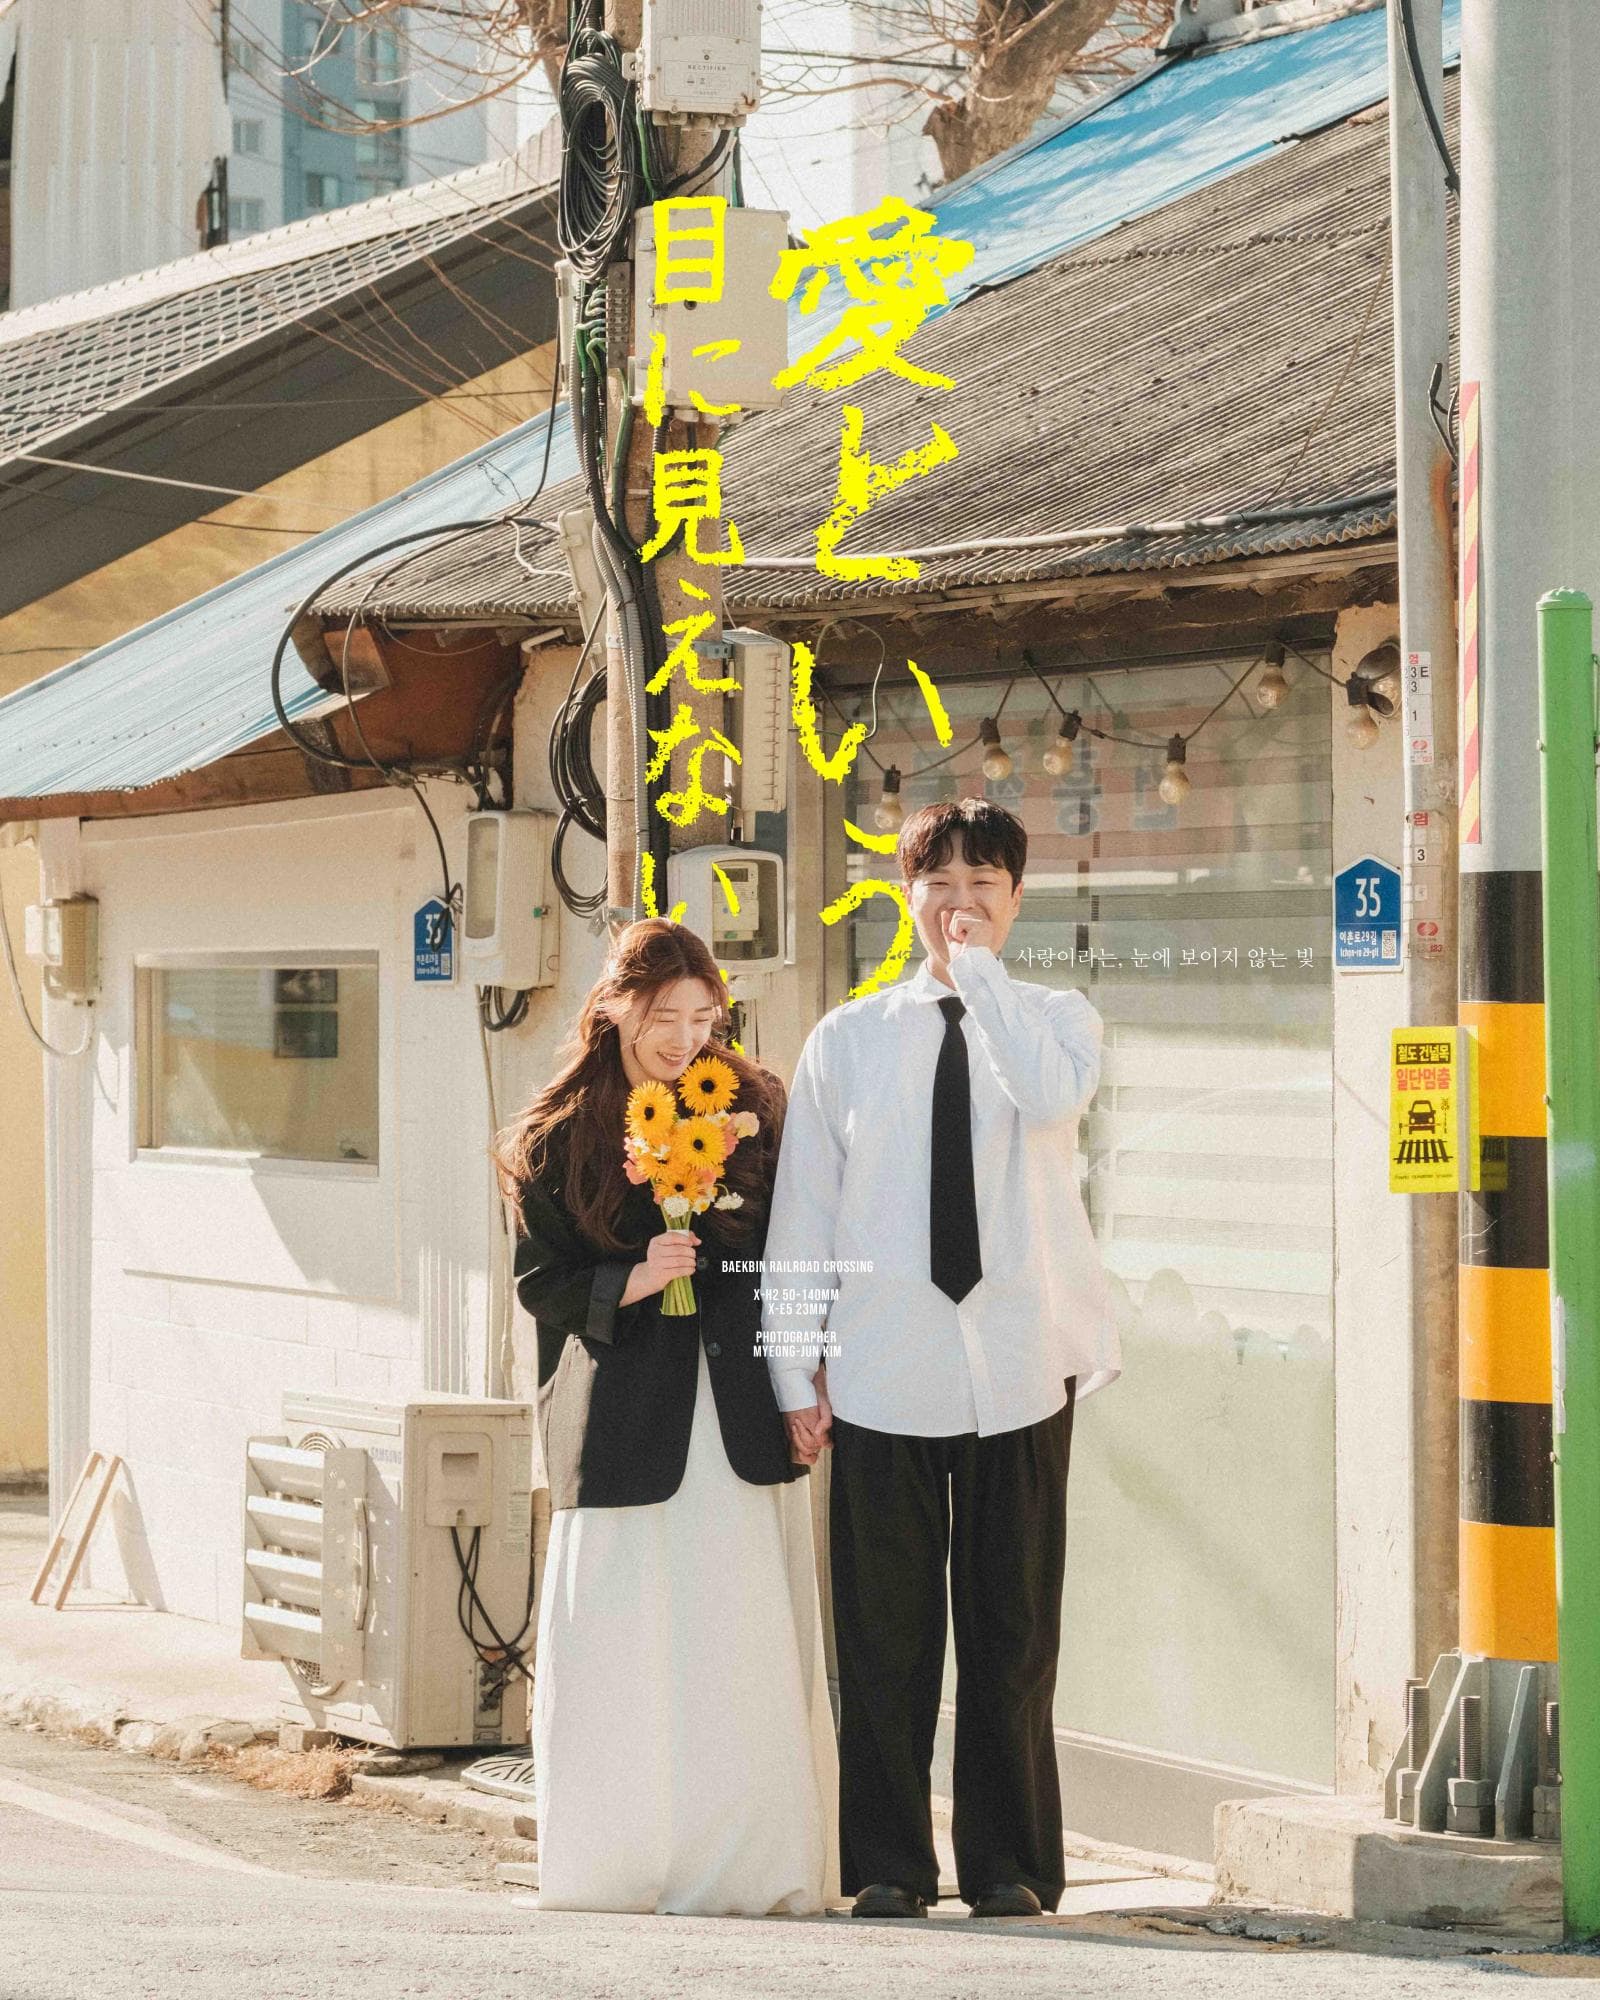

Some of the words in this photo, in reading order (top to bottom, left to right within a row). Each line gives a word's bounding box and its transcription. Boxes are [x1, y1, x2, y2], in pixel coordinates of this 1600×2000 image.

[1411, 681, 1418, 693] 3
[1412, 710, 1417, 721] 1
[1417, 849, 1425, 861] 3
[1355, 877, 1381, 918] 35
[1398, 1045, 1418, 1062] 철도
[1419, 1045, 1449, 1061] 건널목
